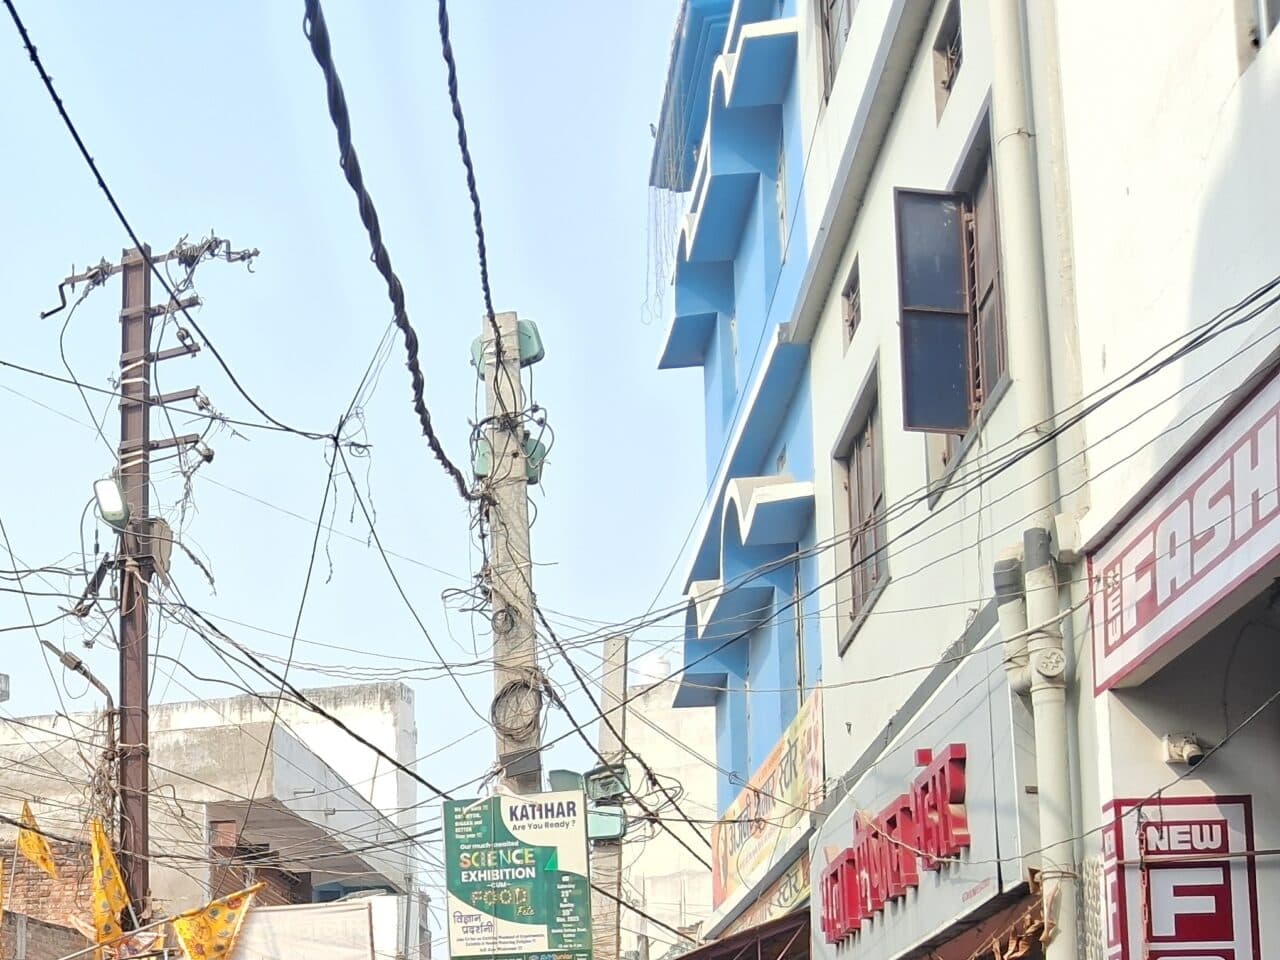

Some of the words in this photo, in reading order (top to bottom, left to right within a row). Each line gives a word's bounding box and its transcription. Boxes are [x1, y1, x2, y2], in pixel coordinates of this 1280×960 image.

[509, 801, 577, 822] KATIHAR
[512, 822, 526, 831] Are
[527, 821, 544, 831] You
[544, 820, 571, 830] Ready
[1147, 822, 1222, 853] NEW
[459, 848, 536, 868] SCIENCE
[461, 867, 536, 883] EXHIBITION
